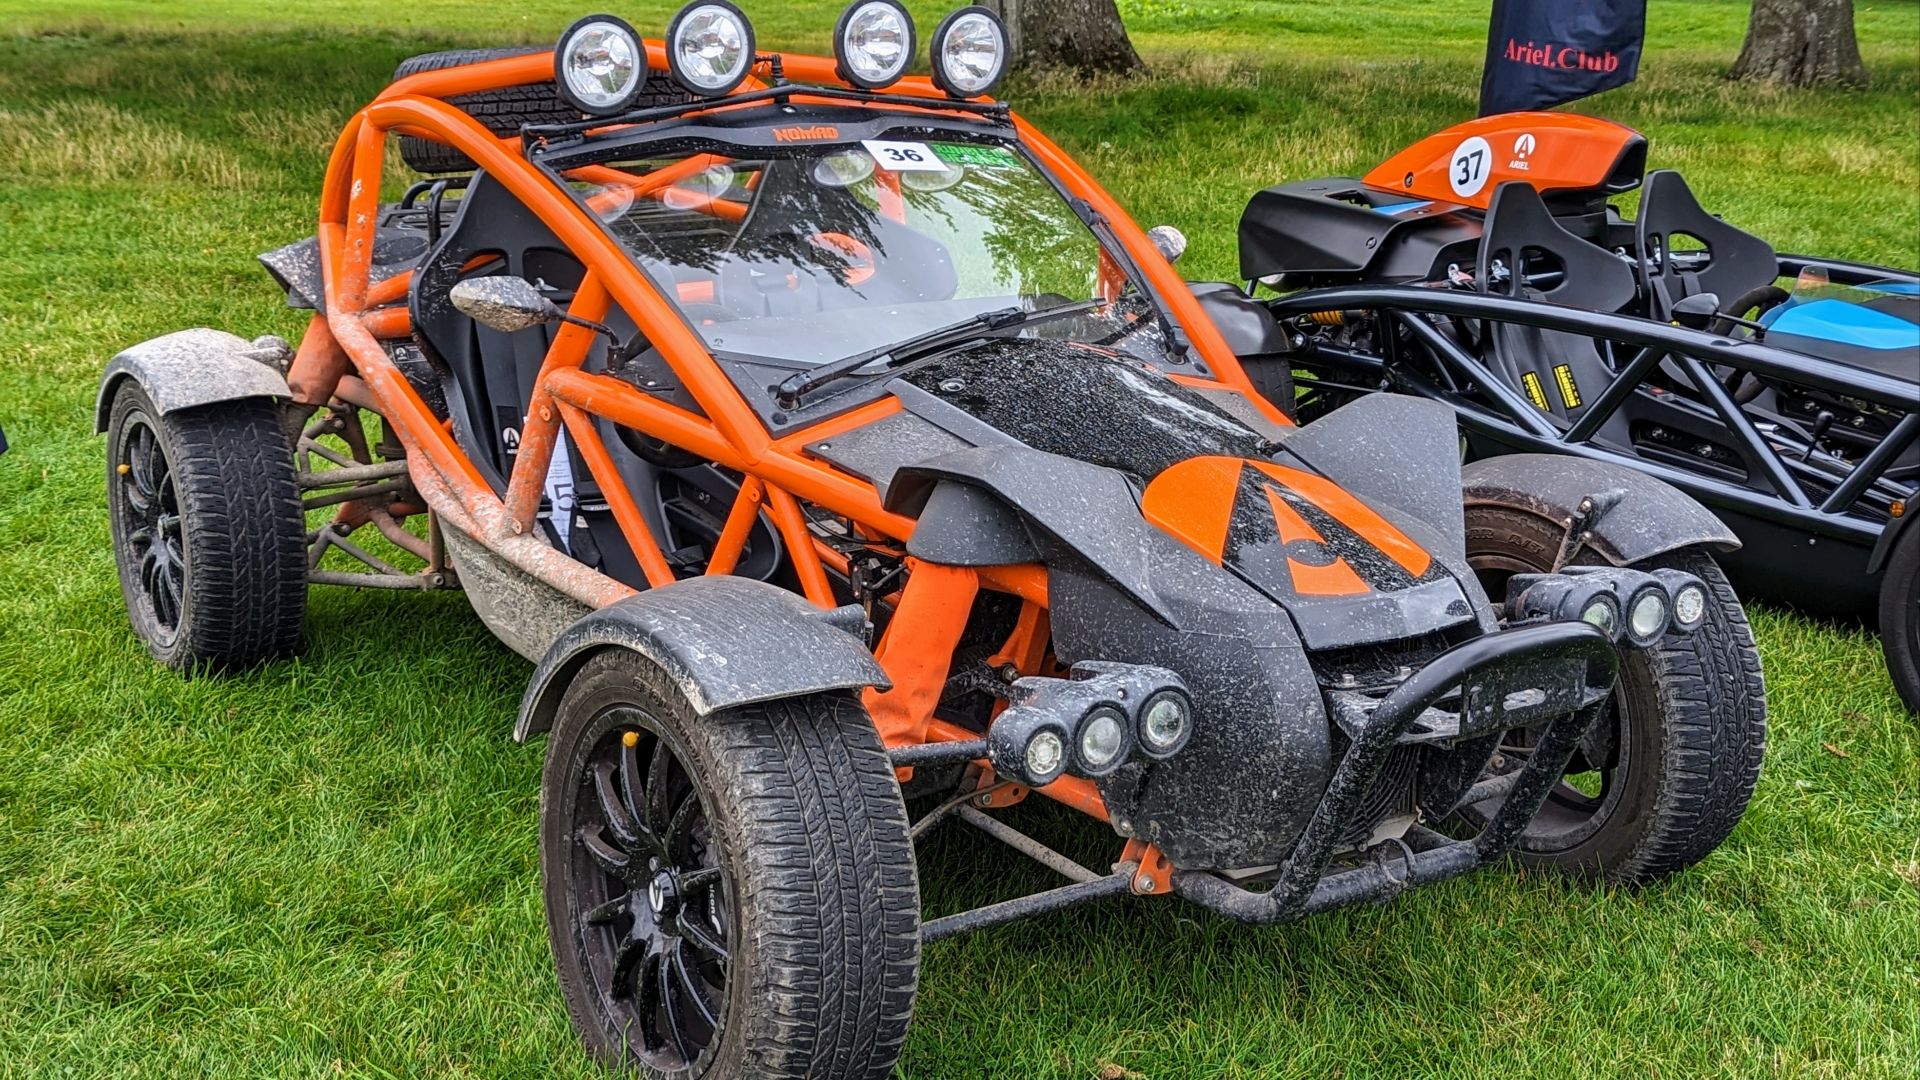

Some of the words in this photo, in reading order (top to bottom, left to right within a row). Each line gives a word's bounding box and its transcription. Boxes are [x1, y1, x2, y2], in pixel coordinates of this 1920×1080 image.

[1504, 38, 1619, 73] Ariel.Club
[773, 125, 839, 142] NOMAD
[883, 148, 924, 162] 36
[1456, 149, 1484, 186] 37
[1508, 160, 1530, 170] ARIEL
